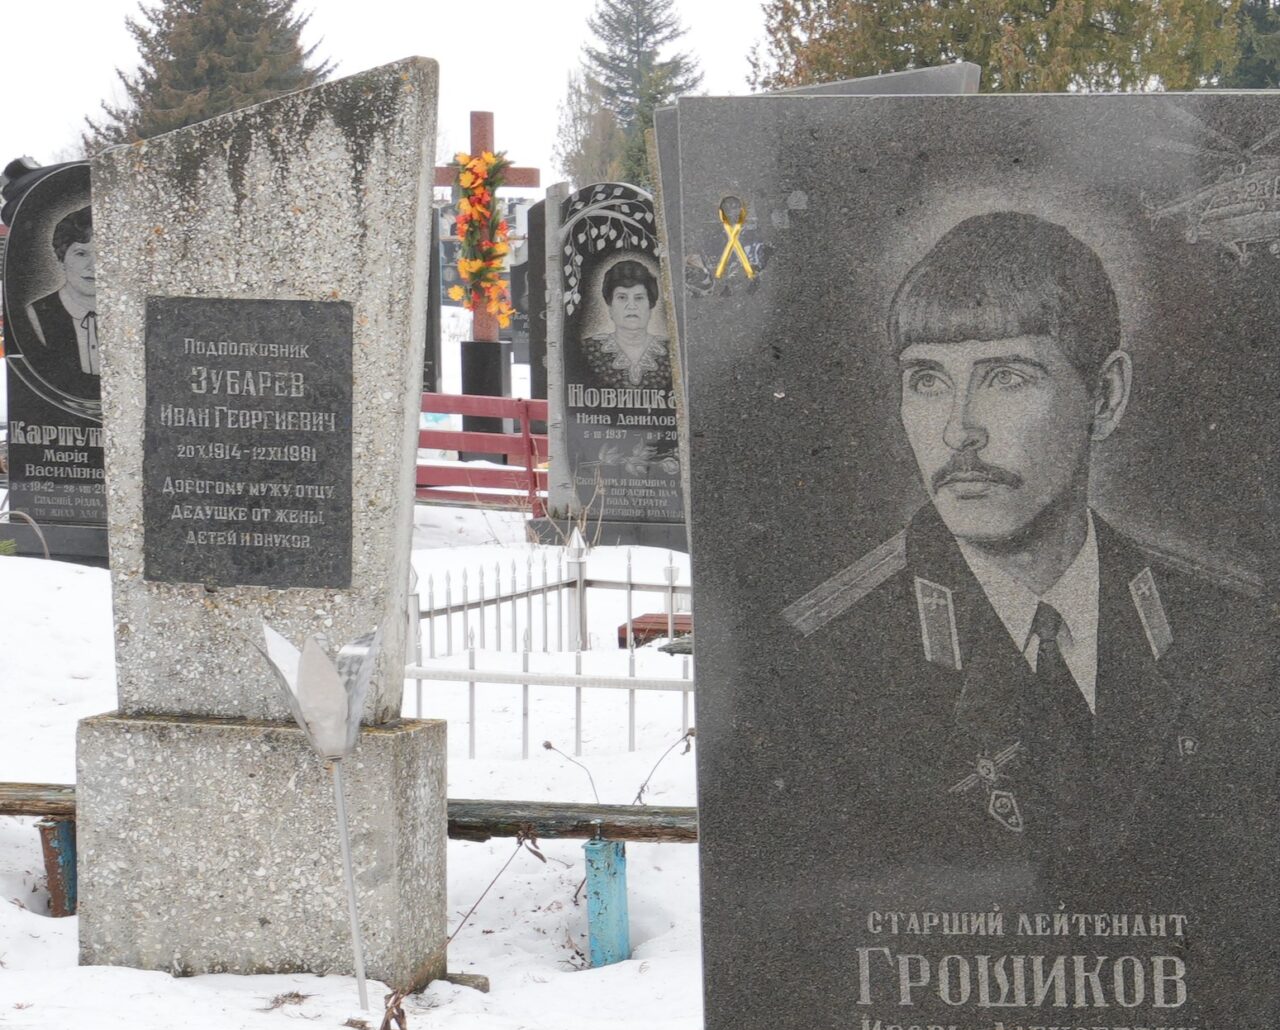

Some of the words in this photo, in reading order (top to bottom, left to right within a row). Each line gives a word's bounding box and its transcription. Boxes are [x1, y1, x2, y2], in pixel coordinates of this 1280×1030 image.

[192, 367, 304, 397] ЗУБАРЕВ
[161, 405, 209, 427] ИВАН
[215, 407, 336, 431] ГЕОРГИЕВИЧ
[576, 413, 611, 425] Нина
[43, 449, 88, 463] Марія
[163, 477, 244, 495] ДОРОГОМУ
[171, 505, 247, 521] ДЕДУШКЕ
[252, 508, 270, 521] ОТ
[186, 530, 236, 545] ДЕТЕЙ
[867, 903, 1004, 936] СТАРШИЙ
[1017, 901, 1188, 936] ЛЕЙТЕНАНТ
[856, 947, 1187, 1008] ГРОШИКОВ
